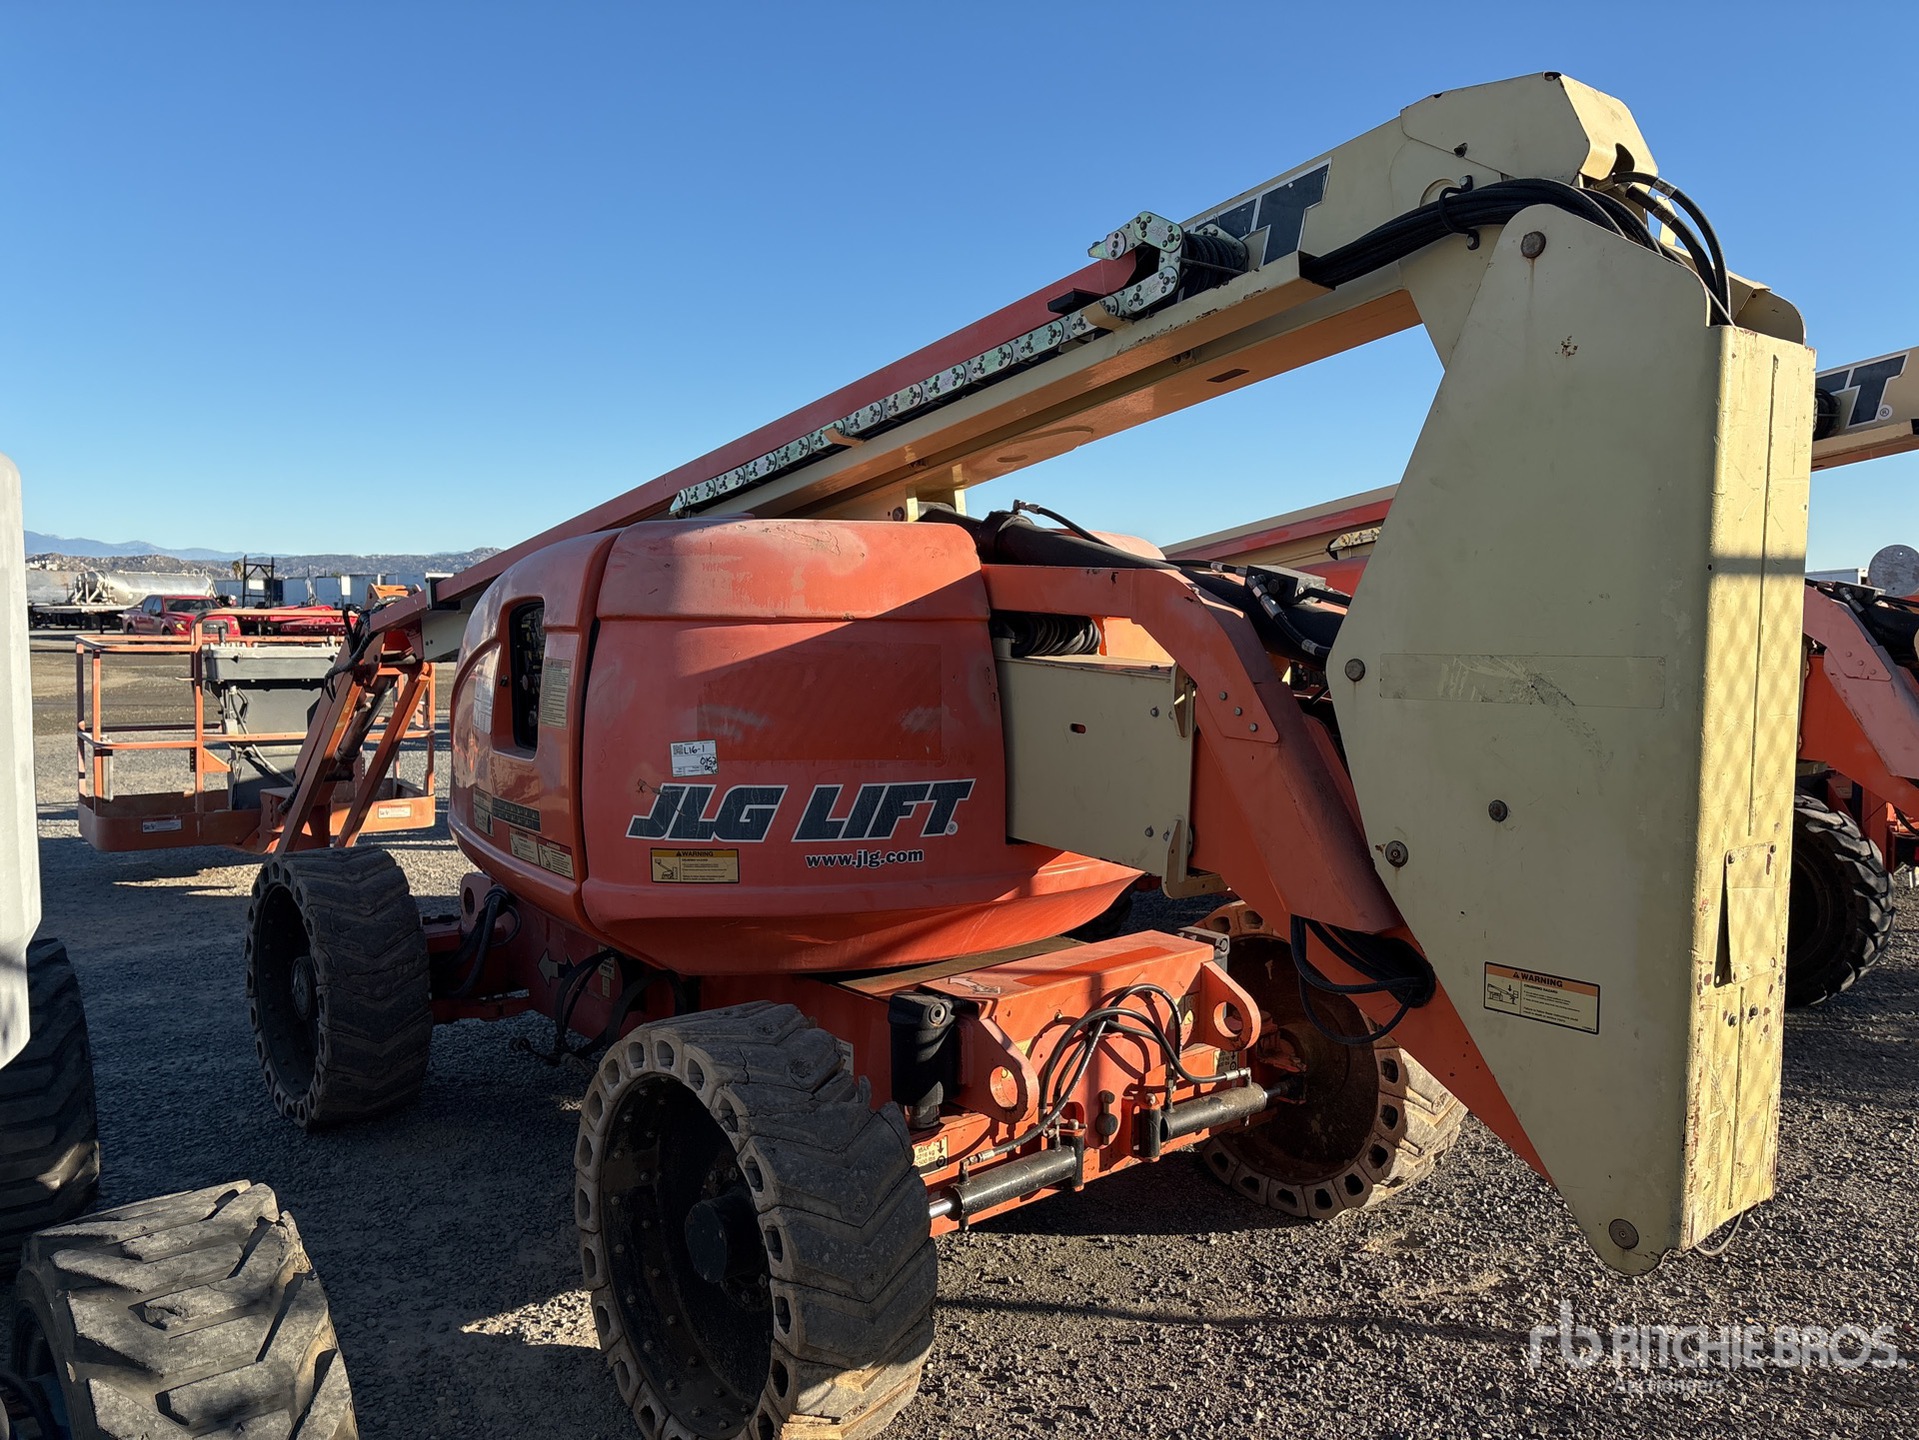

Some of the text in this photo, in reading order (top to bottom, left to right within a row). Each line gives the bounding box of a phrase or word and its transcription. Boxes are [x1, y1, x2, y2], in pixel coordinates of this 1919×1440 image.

[626, 779, 976, 842] JLG LIFT
[806, 849, 924, 868] www.jlg.com
[1521, 972, 1563, 988] WARNING
